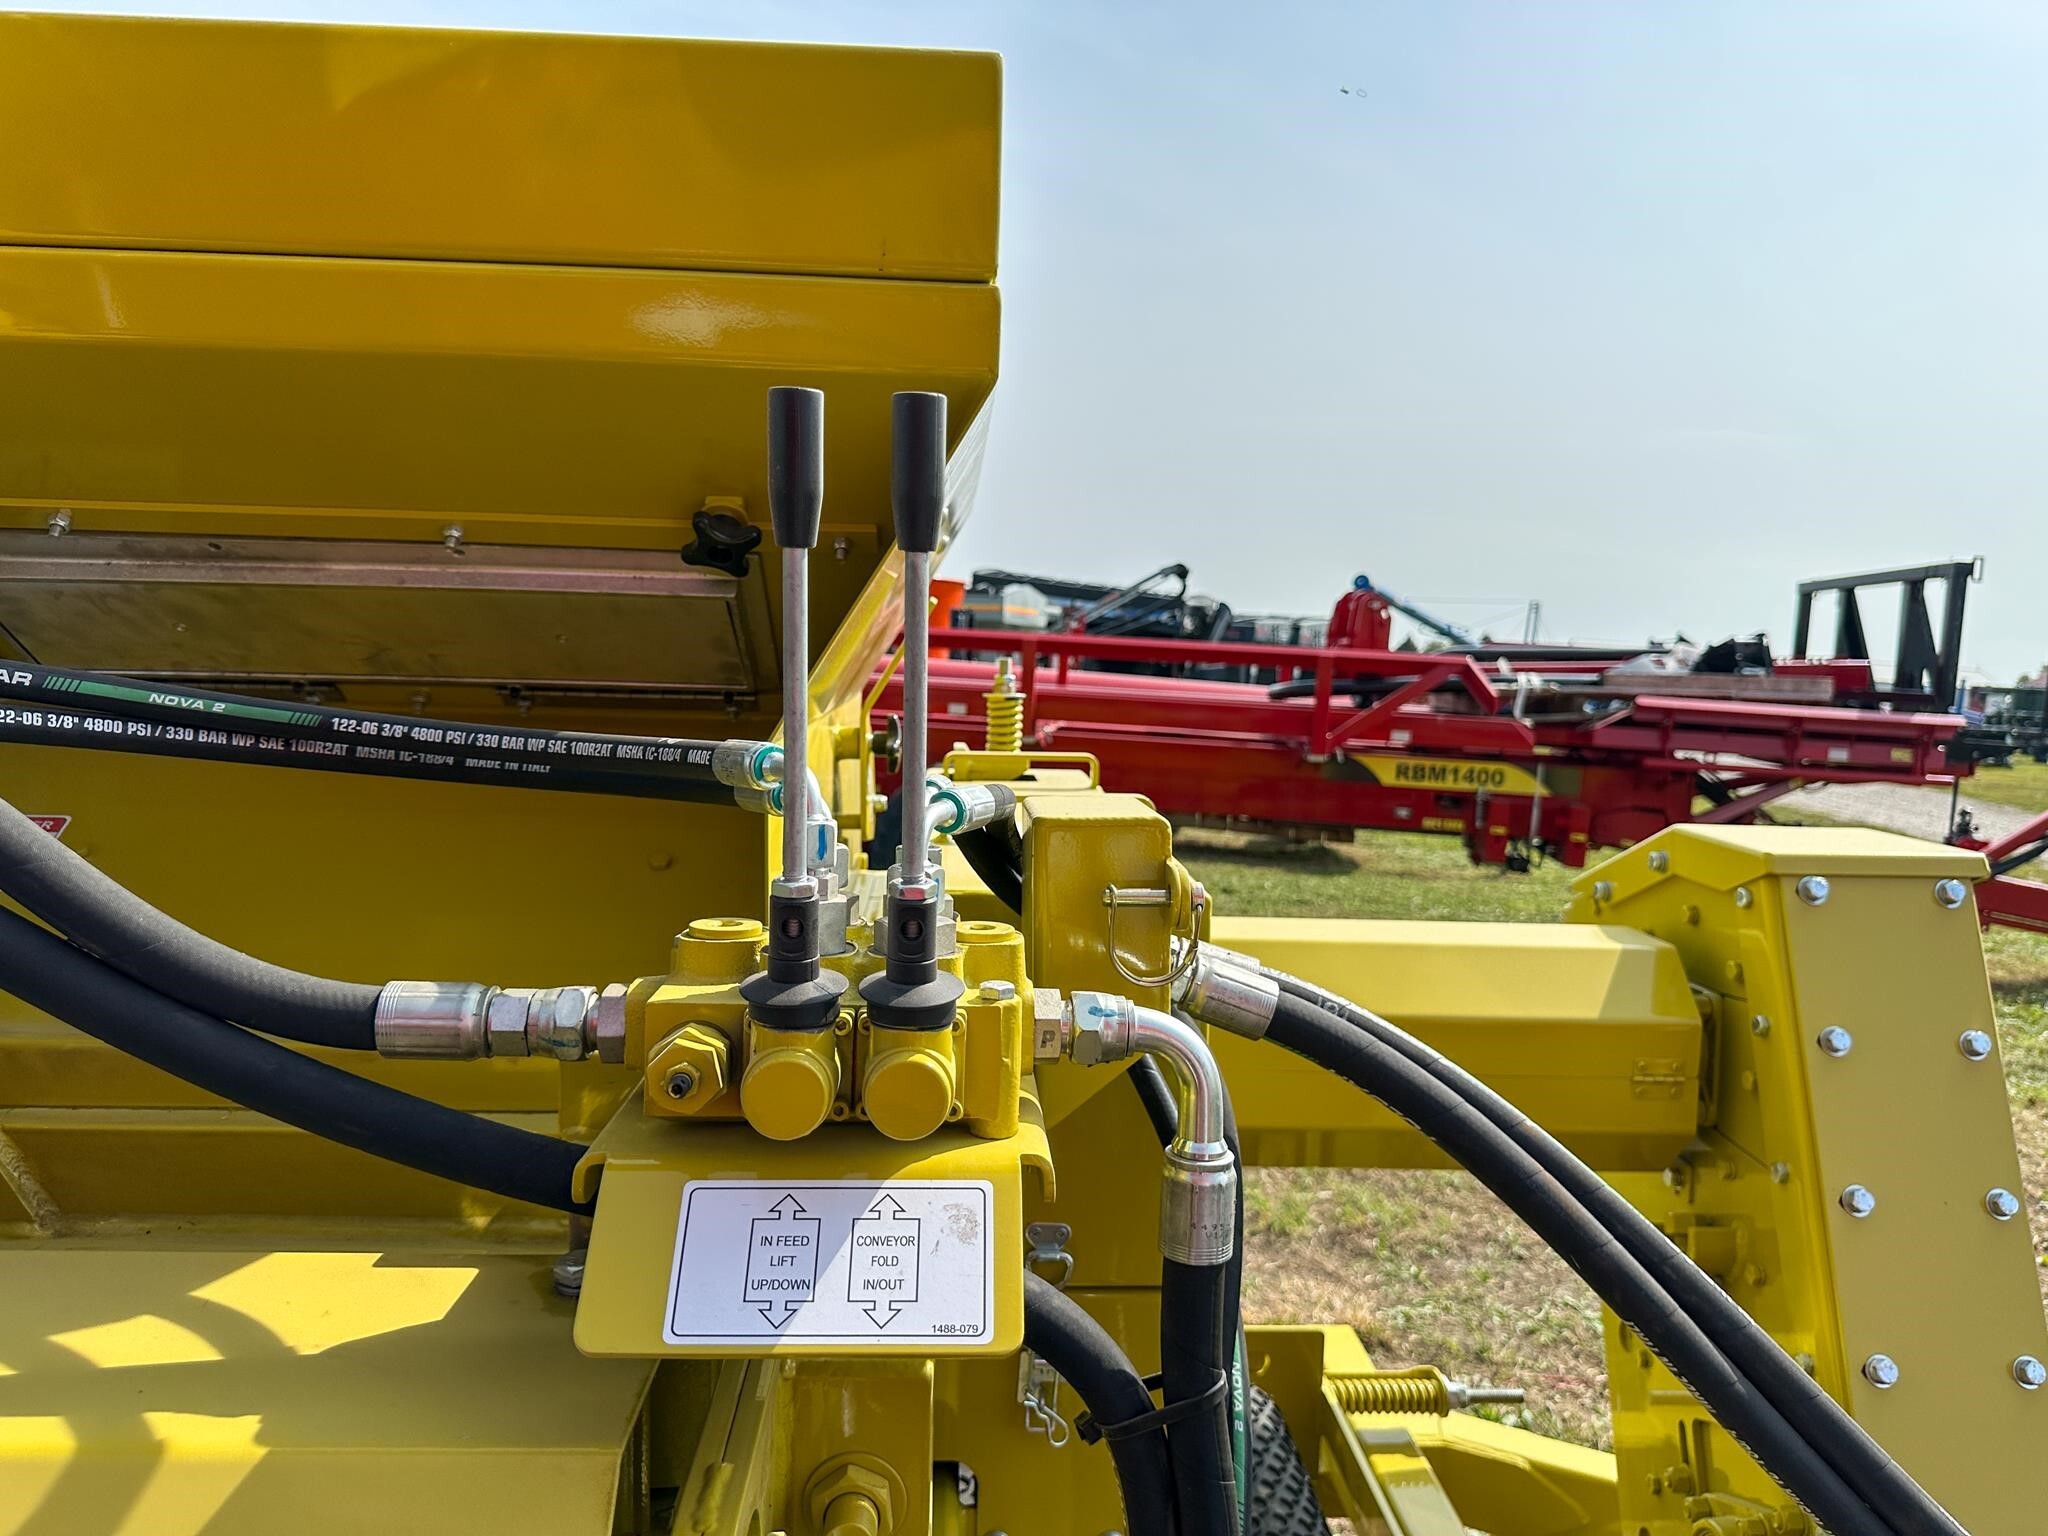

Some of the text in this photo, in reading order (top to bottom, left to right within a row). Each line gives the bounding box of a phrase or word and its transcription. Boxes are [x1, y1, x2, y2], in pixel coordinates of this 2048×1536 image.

[47, 713, 79, 729] 3/8"
[83, 717, 123, 734] 4800
[127, 720, 152, 737] PSI
[154, 724, 163, 737] /
[165, 725, 194, 741] 330
[198, 729, 228, 745] BAR
[231, 733, 255, 748] WP
[258, 736, 286, 751] SAE
[288, 738, 350, 757] 100R2AT
[148, 692, 204, 710] NOVA
[211, 702, 226, 713] 2
[331, 717, 380, 736] 122-06
[410, 726, 443, 743] 4800
[445, 730, 466, 745] PSI
[476, 733, 500, 748] 330
[501, 735, 525, 751] BAR
[526, 738, 546, 752] WP
[547, 739, 568, 754] SAE
[570, 741, 614, 757] 100R2AT
[616, 744, 644, 760] MSHA
[687, 748, 712, 765] MADE
[1394, 761, 1505, 788] RBM1400
[760, 1234, 810, 1247] IN FEED
[856, 1235, 916, 1247] CONVEYOR
[769, 1255, 798, 1267] LIFT
[871, 1255, 899, 1267] FOLD
[751, 1278, 811, 1291] UP/DOWN
[863, 1278, 905, 1290] IN/OUT
[931, 1324, 979, 1334] 1488-079
[1231, 1361, 1244, 1432] NOVA 2
